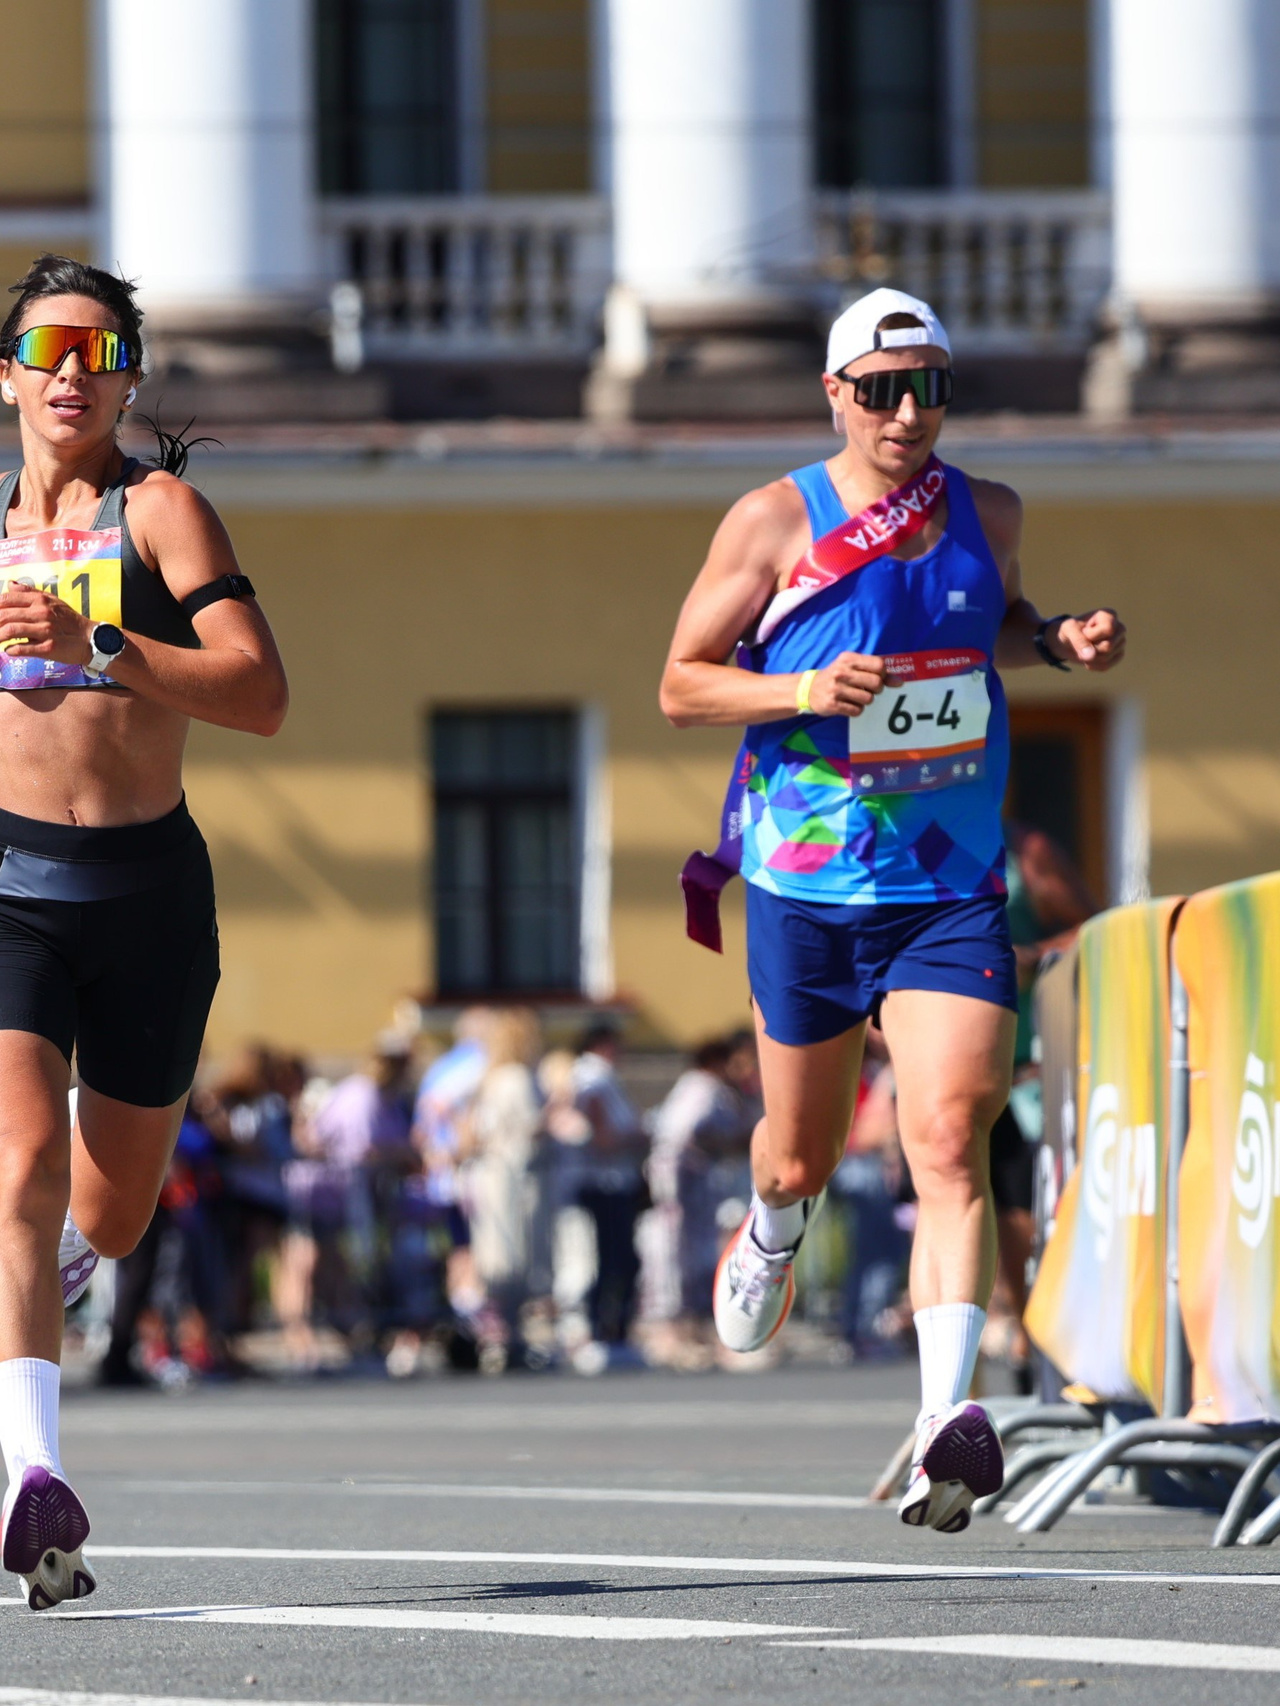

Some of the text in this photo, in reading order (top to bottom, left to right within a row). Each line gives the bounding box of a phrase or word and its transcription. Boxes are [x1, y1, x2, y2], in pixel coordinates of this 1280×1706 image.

[844, 468, 944, 550] СТАФЕТА
[52, 538, 100, 551] 21,1 КМ
[925, 656, 971, 669] ЭСТАФЕТА
[888, 689, 961, 735] 6-4
